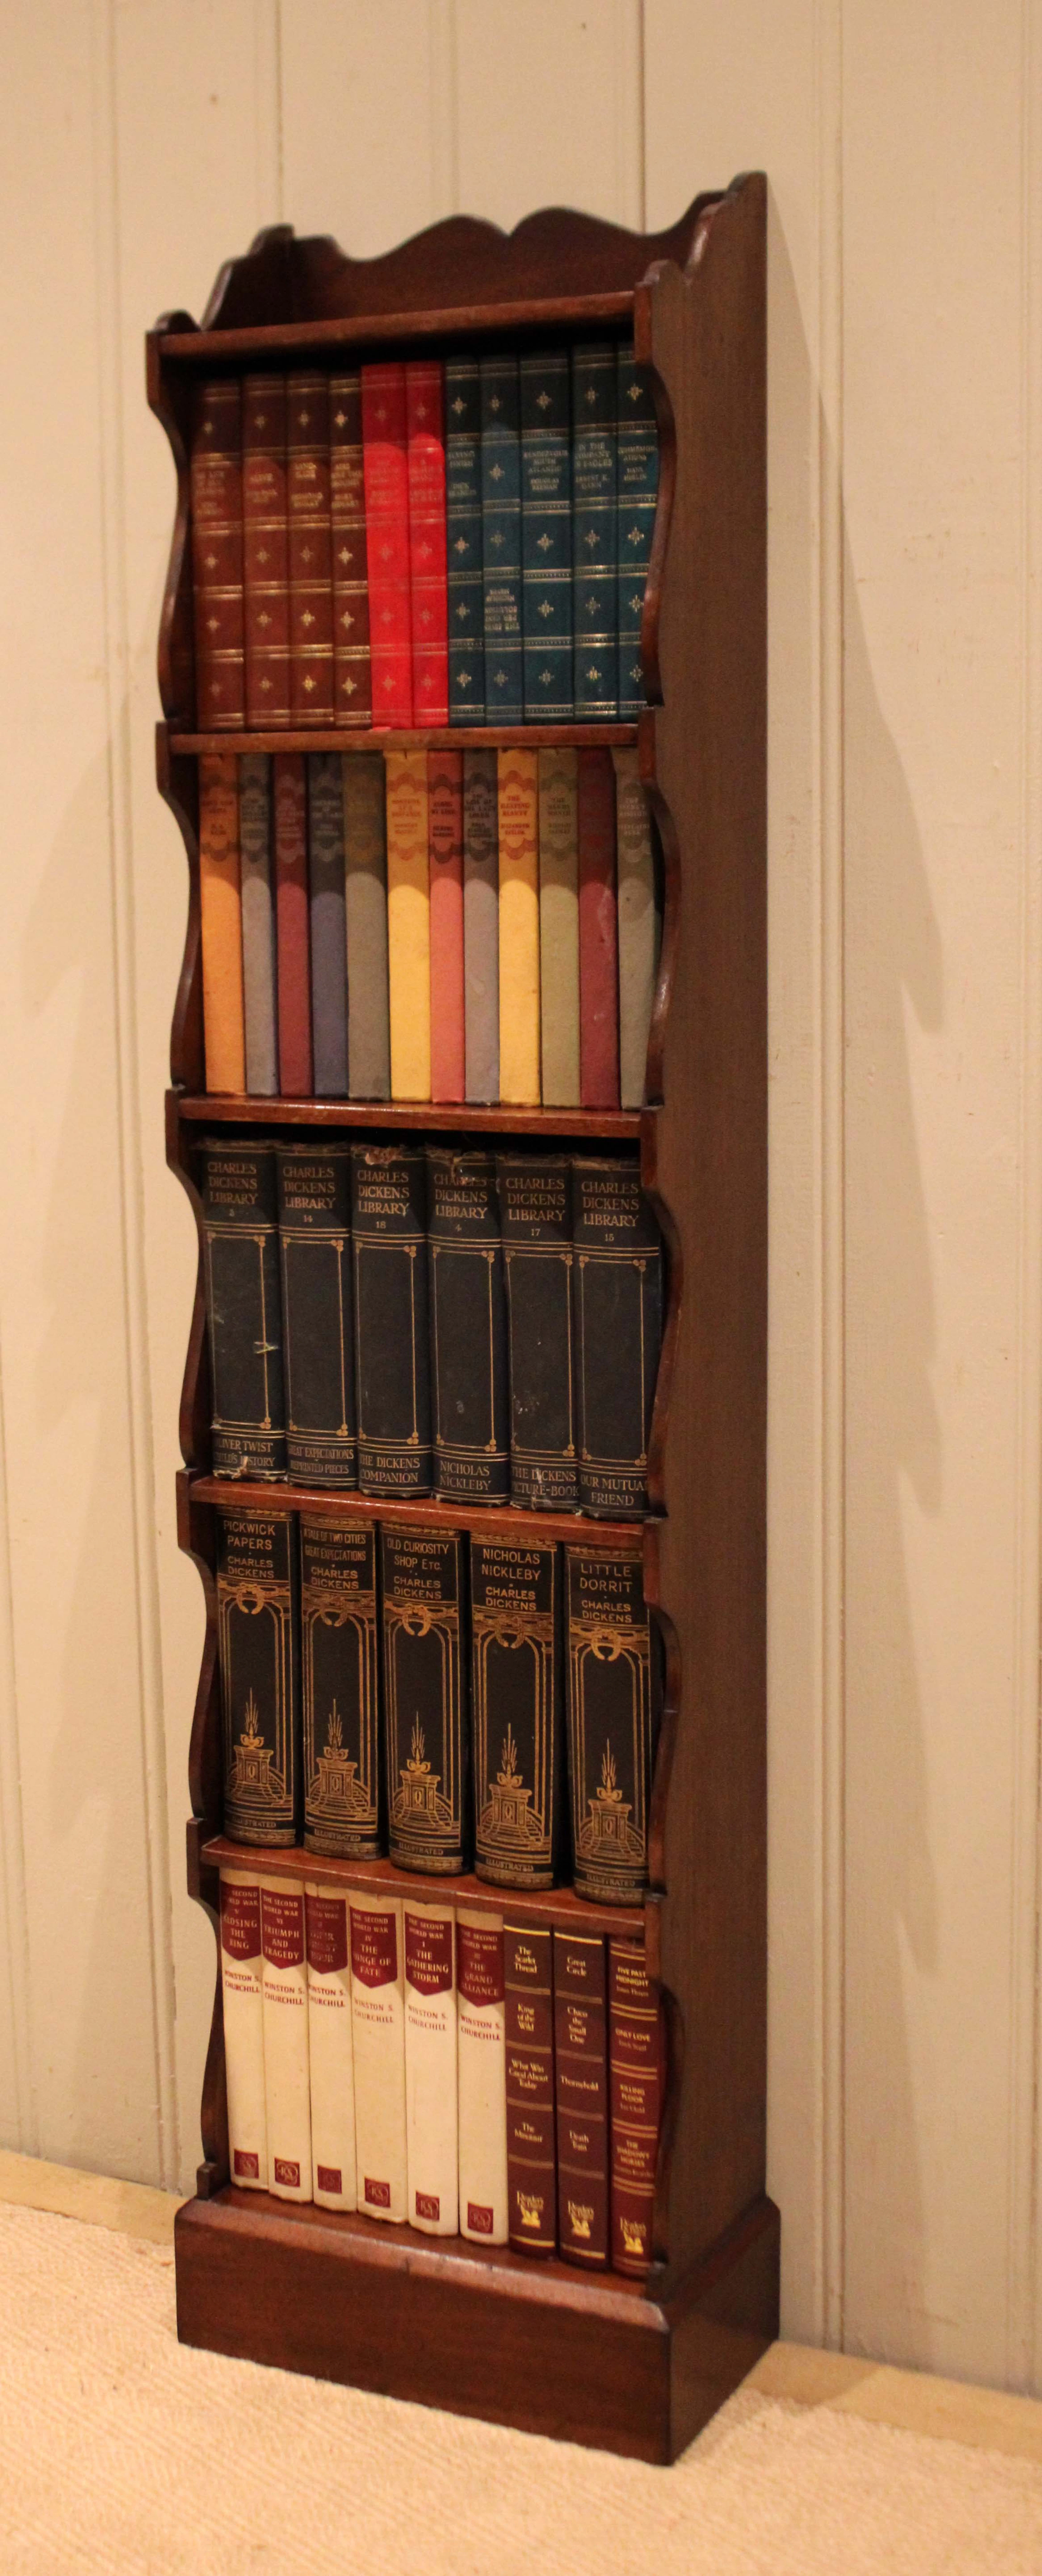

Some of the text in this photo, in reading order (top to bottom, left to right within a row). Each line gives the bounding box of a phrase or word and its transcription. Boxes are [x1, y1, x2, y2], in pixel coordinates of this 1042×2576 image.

[208, 1162, 257, 1174] CHARLES
[283, 1166, 334, 1178] CHARLES
[357, 1169, 409, 1183] CHARLES
[208, 1176, 257, 1190] DICKENS
[284, 1180, 335, 1193] DICKENS
[505, 1178, 565, 1190] CHARLES
[581, 1181, 639, 1194] CHARLES
[210, 1191, 258, 1204] LIBRARY
[358, 1185, 409, 1199] DICKENS
[435, 1189, 487, 1203] DICKENS
[285, 1196, 336, 1209] LIBRARY
[507, 1193, 566, 1205] DICKENS
[583, 1196, 640, 1211] DICKENS
[358, 1201, 410, 1215] LIBRARY
[435, 1204, 488, 1219] LIBRARY
[508, 1208, 565, 1221] LIBRARY
[303, 1214, 313, 1223] 14
[584, 1213, 640, 1227] LIBRARY
[375, 1221, 386, 1230] 18
[531, 1228, 540, 1236] 17
[243, 1441, 273, 1453] TWIST
[305, 1447, 354, 1459] EXPECTATIONS
[290, 1460, 349, 1474] REPRINTED PIECES
[377, 1456, 420, 1469] DICKENS
[440, 1460, 491, 1476] NICHOLAS
[361, 1468, 418, 1483] COMPANION
[512, 1466, 529, 1479] THE
[440, 1474, 492, 1491] NICKLEBY
[581, 1474, 646, 1491] OUR MUTUA
[591, 1491, 635, 1506] FRIEND
[223, 1520, 275, 1536] PICKWICK
[227, 1535, 273, 1551] PAPERS
[329, 1532, 343, 1543] TWO
[344, 1534, 366, 1544] CITIES
[387, 1537, 449, 1555] OLD CURIOSITY
[320, 1548, 366, 1561] EXPECTATIONS
[483, 1548, 540, 1564] NICHOLAS
[228, 1556, 273, 1568] CHARLES
[394, 1555, 418, 1568] SHOP
[228, 1566, 274, 1579] DICKENS
[310, 1566, 358, 1579] CHARLES
[481, 1564, 541, 1580] NICKLEBY
[581, 1562, 633, 1577] LITTLE
[311, 1577, 359, 1590] DICKENS
[394, 1575, 441, 1588] CHARLES
[579, 1577, 633, 1593] DORRIT
[394, 1587, 442, 1600] DICKENS
[486, 1586, 536, 1600] CHARLES
[486, 1597, 536, 1611] DICKENS
[581, 1600, 631, 1613] CHARLES
[582, 1610, 632, 1624] DICKENS
[314, 1829, 361, 1842] ILLUSTRATED
[399, 1842, 444, 1856] ILLUSTRATED
[486, 1857, 534, 1873] ILLUSTRATED
[586, 1873, 635, 1887] ILLUSTRATED
[263, 1895, 298, 1908] THE SECOND
[263, 1904, 298, 1917] WORLD WAR
[224, 1916, 258, 1928] CLOSING
[364, 1915, 389, 1924] SECOND
[420, 1921, 444, 1930] SECOND
[230, 1929, 246, 1939] THE
[263, 1924, 300, 1939] TRIUMPH
[374, 1925, 388, 1933] WAR
[429, 1931, 444, 1940] WAR
[272, 1938, 289, 1948] AND
[474, 1933, 497, 1942] SECOND
[229, 1939, 249, 1950] RING
[361, 1944, 378, 1955] THE
[264, 1946, 299, 1960] TRAGEDY
[415, 1950, 433, 1961] THE
[380, 1958, 391, 1966] OF
[407, 1957, 449, 1974] GATHERING
[470, 1962, 485, 1972] THE
[225, 1970, 252, 1981] WINSTON
[360, 1965, 381, 1977] FATE
[413, 1971, 440, 1983] STORM
[465, 1973, 493, 1985] GRAND
[225, 1981, 260, 1993] CHURCHILL
[264, 1981, 295, 1994] WINSTON
[308, 1984, 336, 1996] WINSTON
[462, 1982, 499, 1997] ALLIANCE
[265, 1992, 304, 2006] CHURCHILL
[308, 1994, 346, 2008] CHURCHILL
[354, 1998, 384, 2011] WINSTON
[354, 2009, 393, 2023] CHURCHILL
[408, 2004, 438, 2019] WINSTON
[408, 2015, 447, 2031] CHURCHILL
[461, 2014, 492, 2029] WINSTON
[461, 2026, 501, 2040] CHURCHILL
